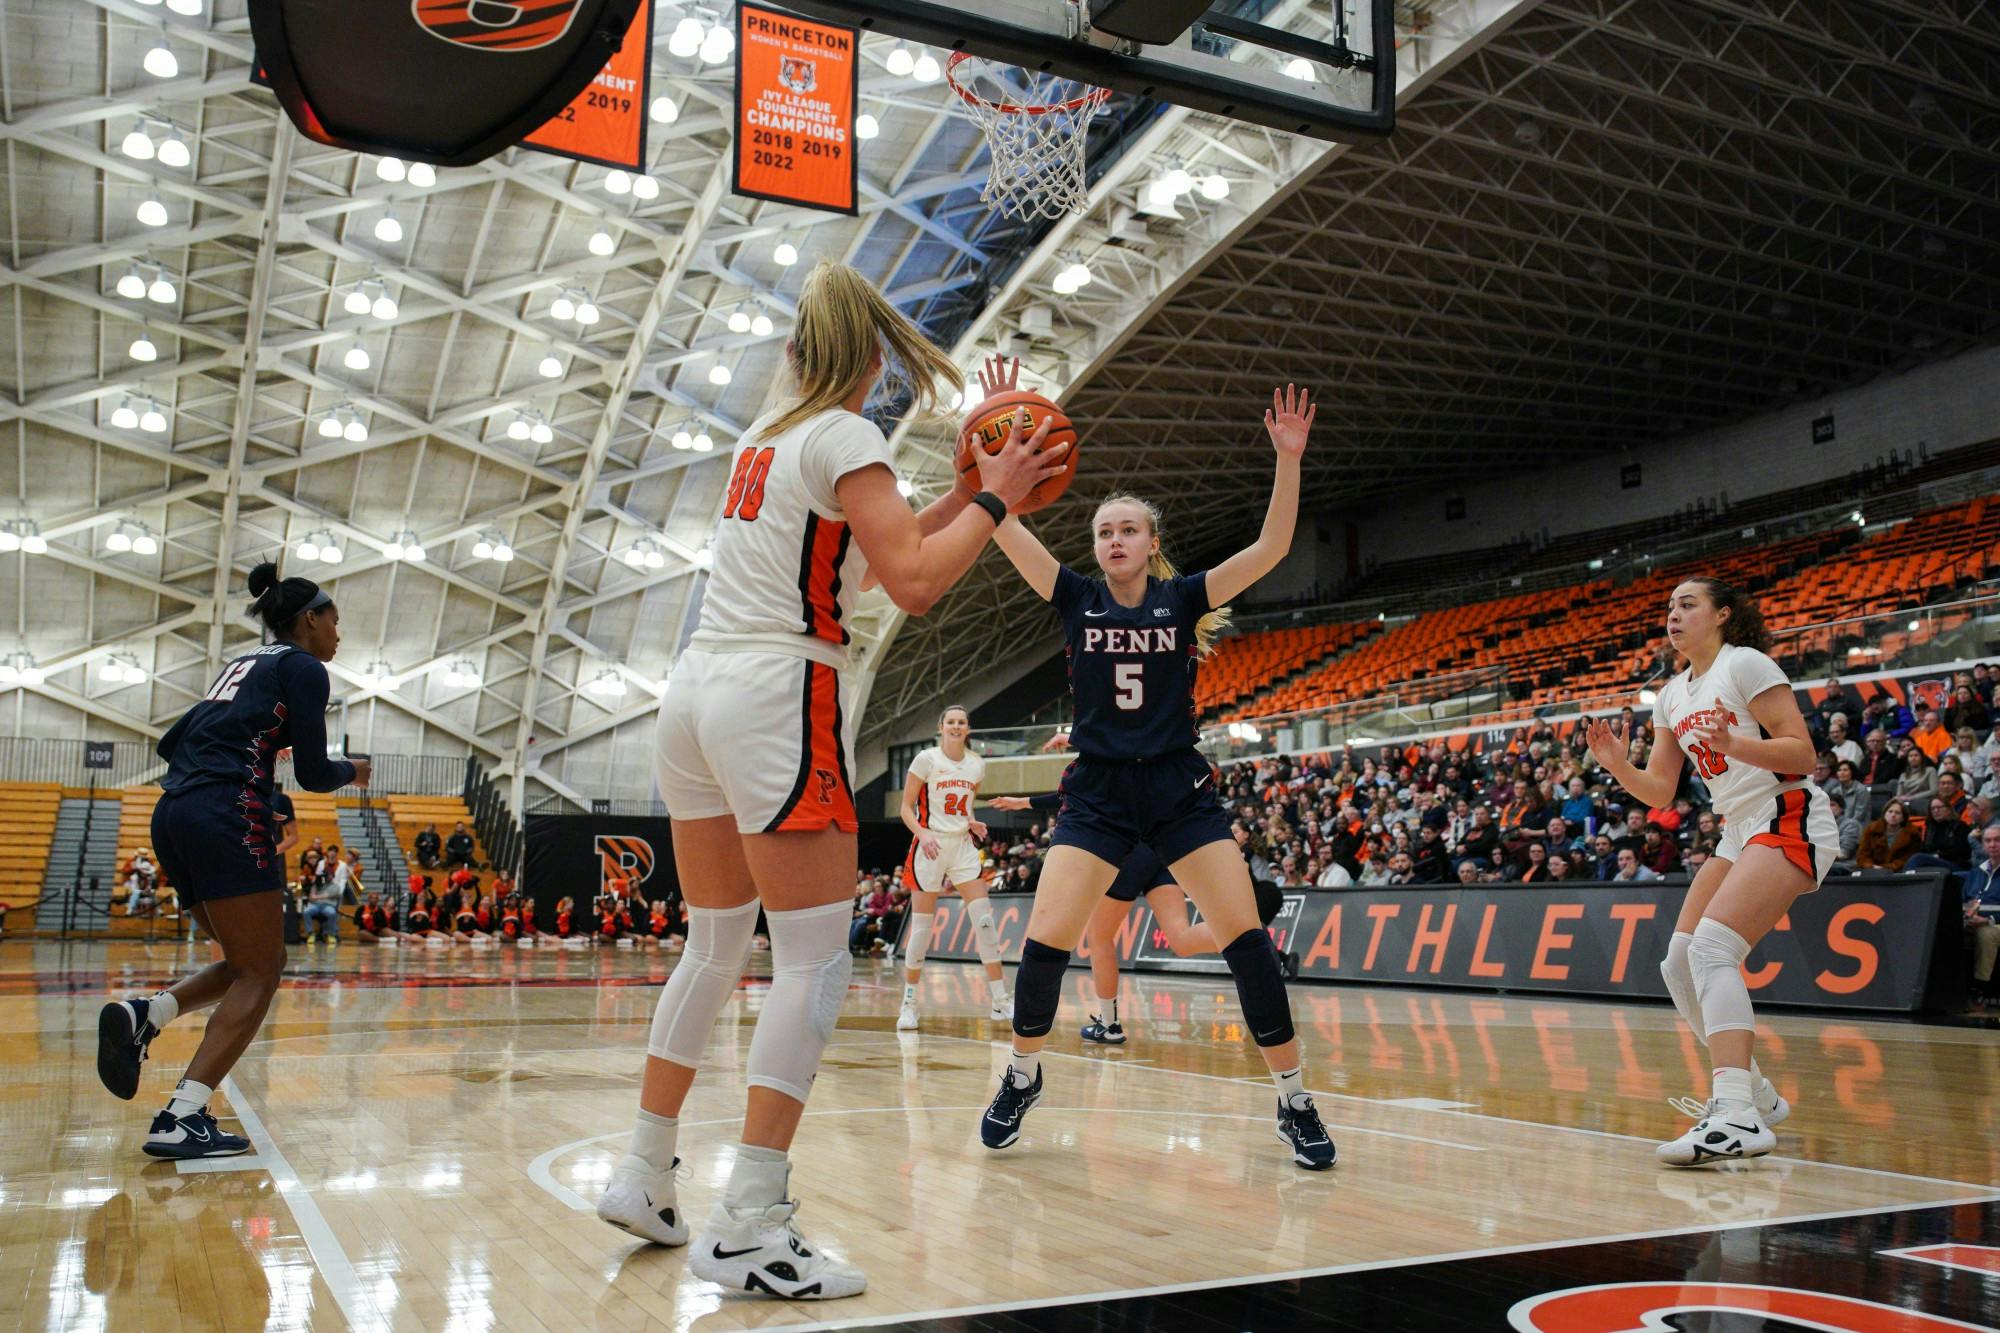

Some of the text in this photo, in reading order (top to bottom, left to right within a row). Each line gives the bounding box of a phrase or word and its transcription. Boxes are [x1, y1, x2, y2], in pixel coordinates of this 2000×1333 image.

[747, 15, 849, 51] PRINCETON
[750, 33, 843, 61] WOMEN'S BASKETBALL
[587, 91, 631, 113] 2019
[757, 99, 837, 125] TOURNAMENT
[762, 89, 831, 113] IVY LEAGUE
[747, 108, 846, 142] CHAMPIONS
[753, 129, 841, 159] 2018 2019
[753, 150, 794, 170] 2022
[1083, 626, 1177, 653] PENN
[206, 659, 257, 701] 12
[1115, 663, 1143, 710] 5
[1488, 729, 1506, 743] 114
[90, 750, 111, 761] 109
[1688, 740, 1729, 780] 10
[595, 805, 608, 813] 112
[944, 793, 969, 816] 24
[1303, 902, 1886, 994] ATHLETCS
